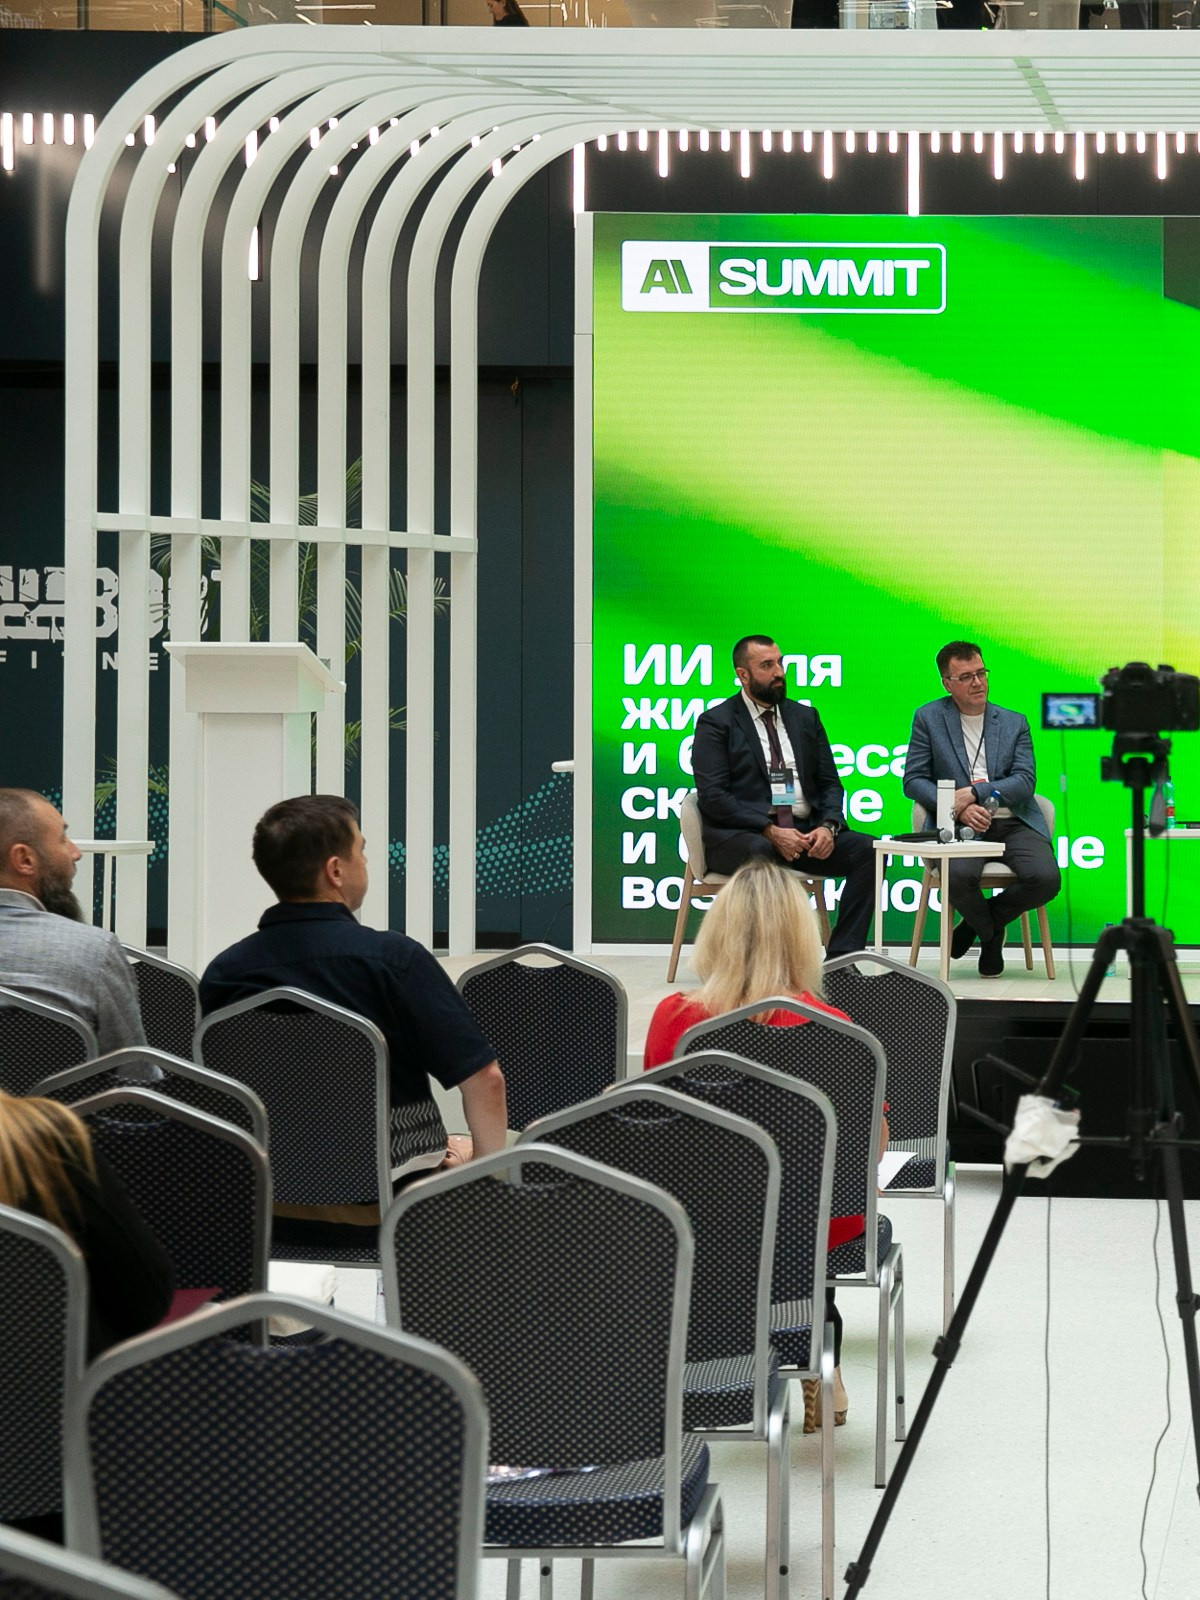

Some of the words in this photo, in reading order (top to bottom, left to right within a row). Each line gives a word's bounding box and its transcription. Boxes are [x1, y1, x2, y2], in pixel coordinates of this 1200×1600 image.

[719, 258, 930, 296] SUMMIT
[623, 644, 713, 685] ИИ
[623, 742, 657, 775] и
[622, 832, 656, 864] и
